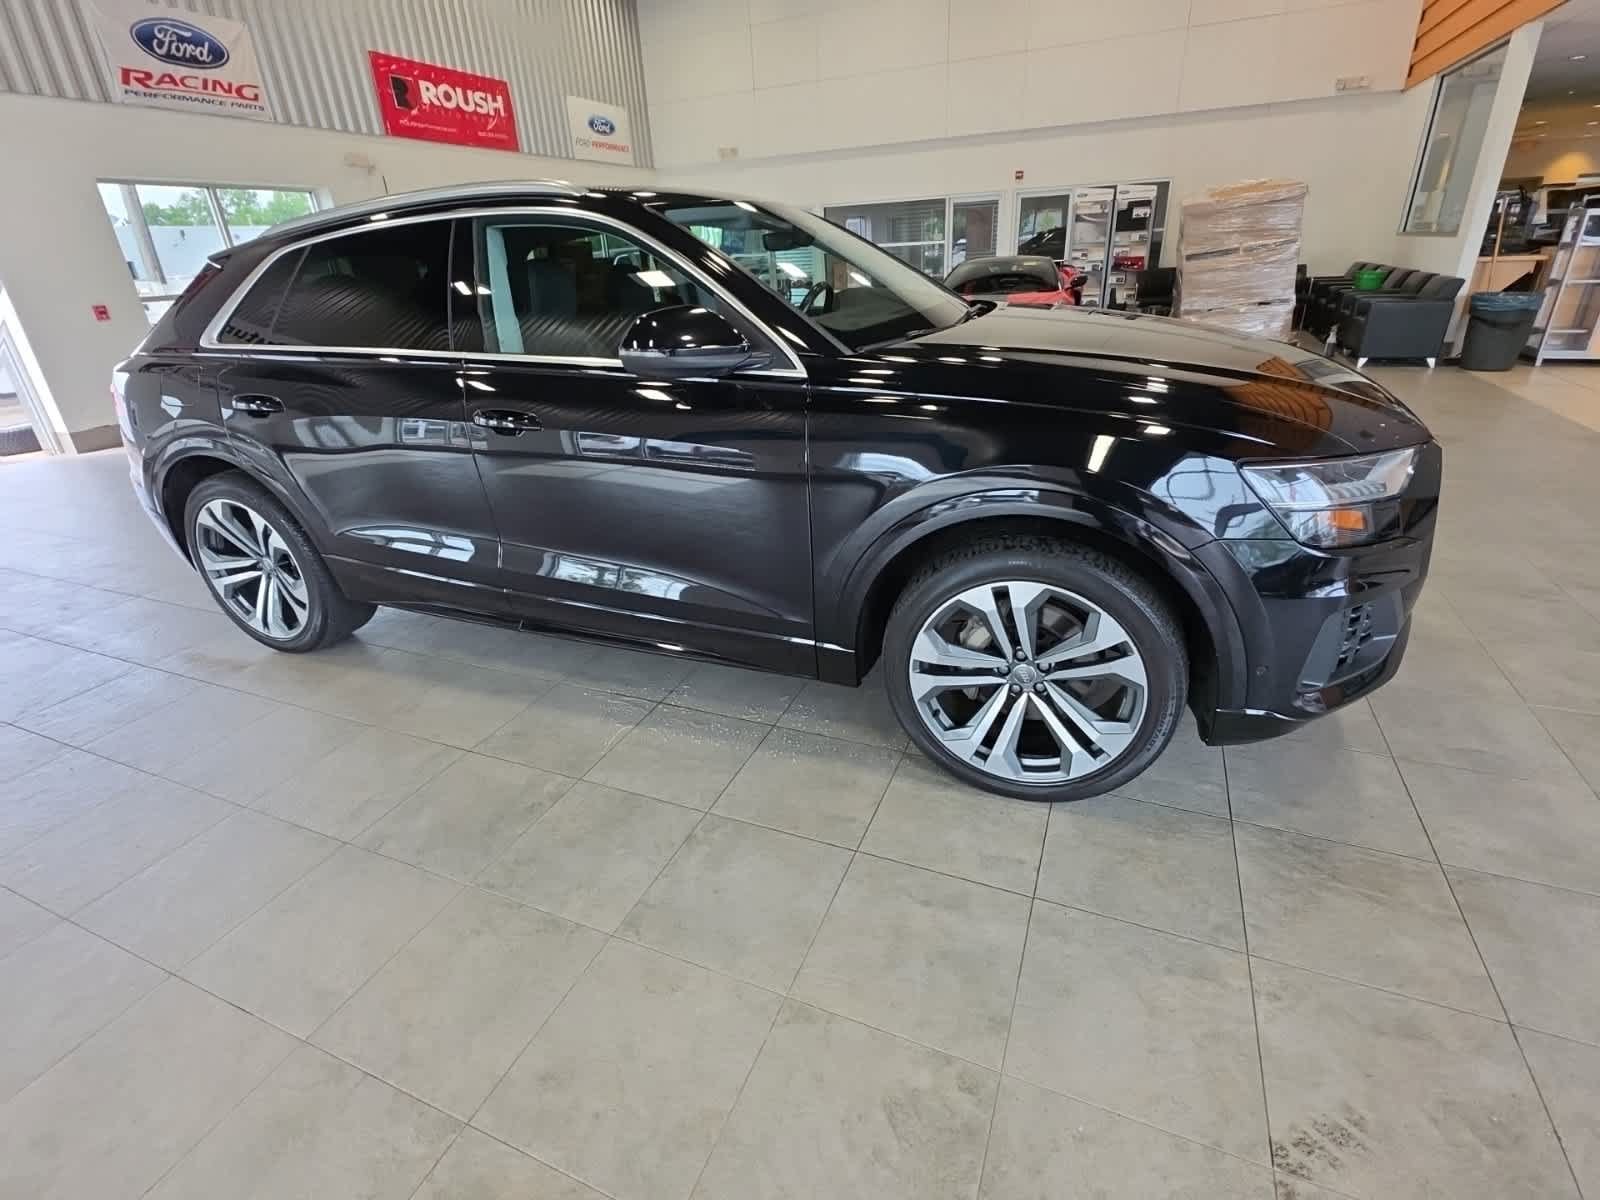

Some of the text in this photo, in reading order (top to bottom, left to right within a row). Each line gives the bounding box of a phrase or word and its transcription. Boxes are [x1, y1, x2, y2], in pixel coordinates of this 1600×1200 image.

[152, 24, 213, 63] Ford
[119, 66, 260, 102] RACING
[123, 88, 266, 112] PERFORMANCE PARTS
[418, 79, 505, 117] ROUSH
